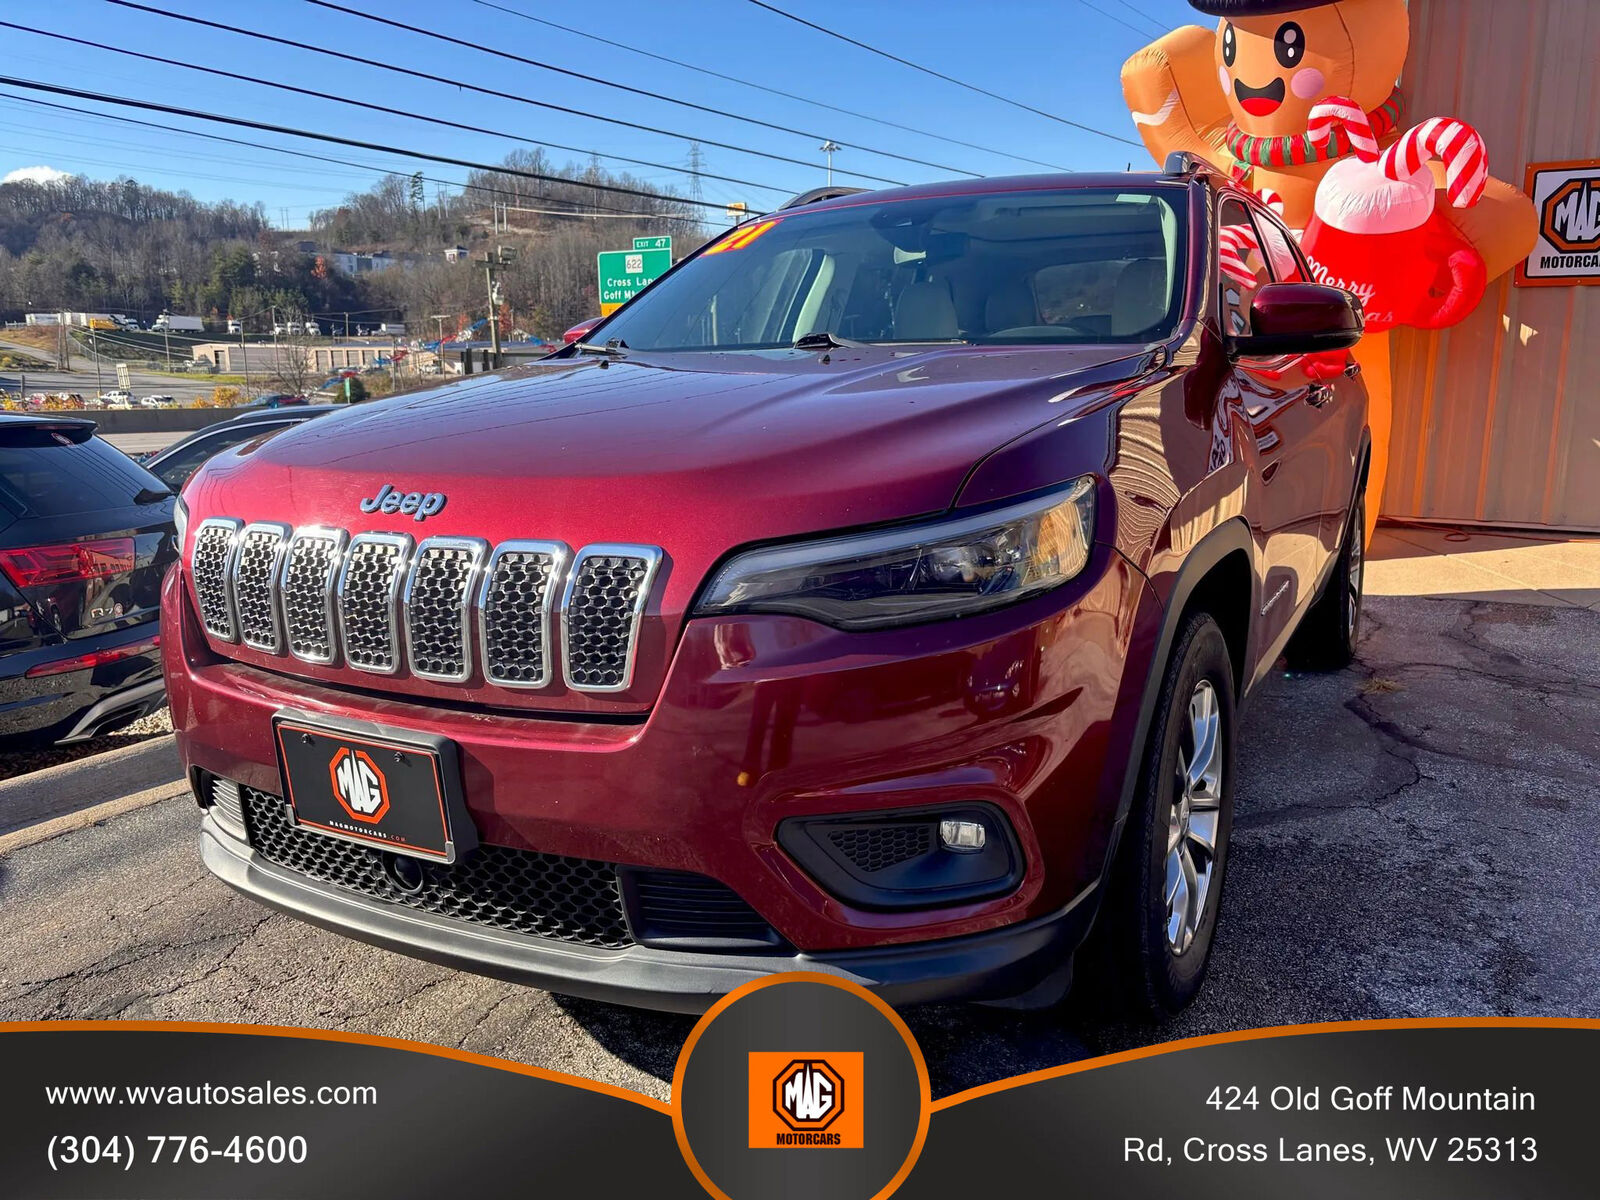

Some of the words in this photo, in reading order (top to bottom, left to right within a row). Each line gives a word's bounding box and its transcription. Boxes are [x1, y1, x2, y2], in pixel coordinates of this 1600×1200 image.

[655, 238, 666, 247] 47
[626, 259, 642, 270] 622
[1540, 255, 1600, 269] MOTORCA
[607, 278, 632, 287] Cross
[1306, 256, 1376, 307] Merry
[603, 290, 621, 300] Goff
[360, 484, 447, 521] Jeep
[337, 750, 381, 813] MAG
[329, 820, 406, 842] MAGMOTORCARS.COM
